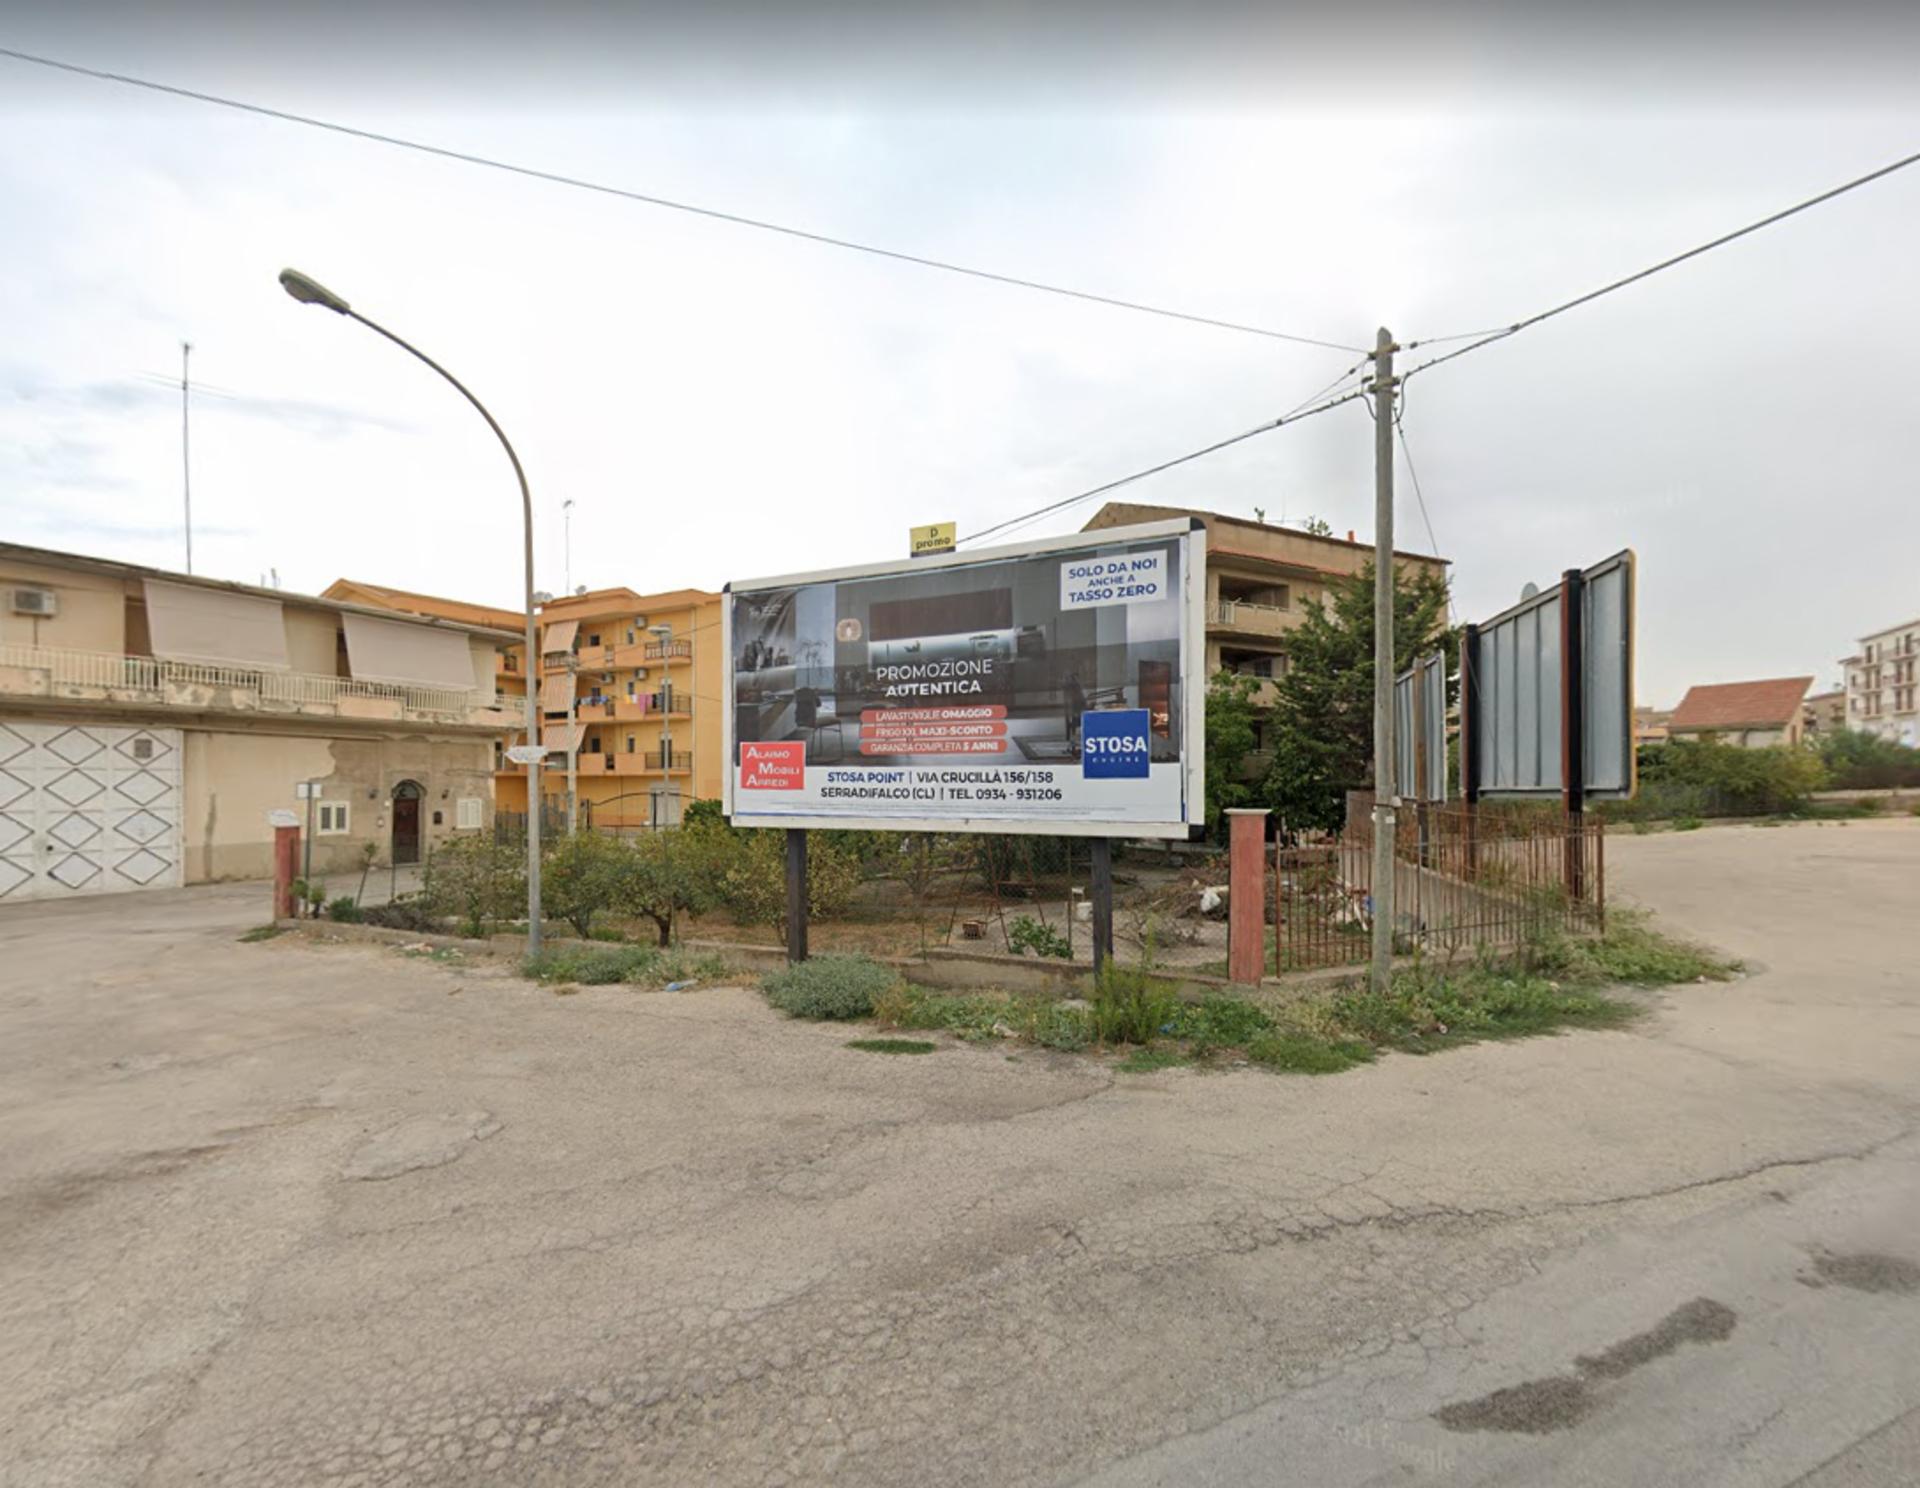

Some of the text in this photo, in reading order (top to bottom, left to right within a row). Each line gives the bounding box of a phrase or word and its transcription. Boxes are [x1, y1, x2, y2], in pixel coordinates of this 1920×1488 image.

[1069, 558, 1157, 579] SOLO DA NOI
[1088, 574, 1136, 587] ANCHE A
[1069, 583, 1157, 603] TASSO ZERO
[877, 659, 992, 680] PROMOZIONE
[885, 680, 982, 697] AUTENTICA
[941, 708, 992, 718] OMAGGIO
[920, 725, 992, 736] MAXI-SCONTO
[870, 743, 914, 752] GARANZIA
[914, 741, 962, 752] COMPLETA
[1085, 736, 1147, 753] STOSA
[827, 772, 864, 783] STOSA
[867, 772, 905, 783] POINT
[916, 772, 938, 783] VIA
[1004, 771, 1053, 784] 156/158
[821, 787, 910, 799] SERRADIFALCO
[912, 787, 935, 800] (CL)
[949, 788, 974, 800] TEL.
[976, 788, 1007, 800] 0934
[1016, 788, 1062, 800] 931206
